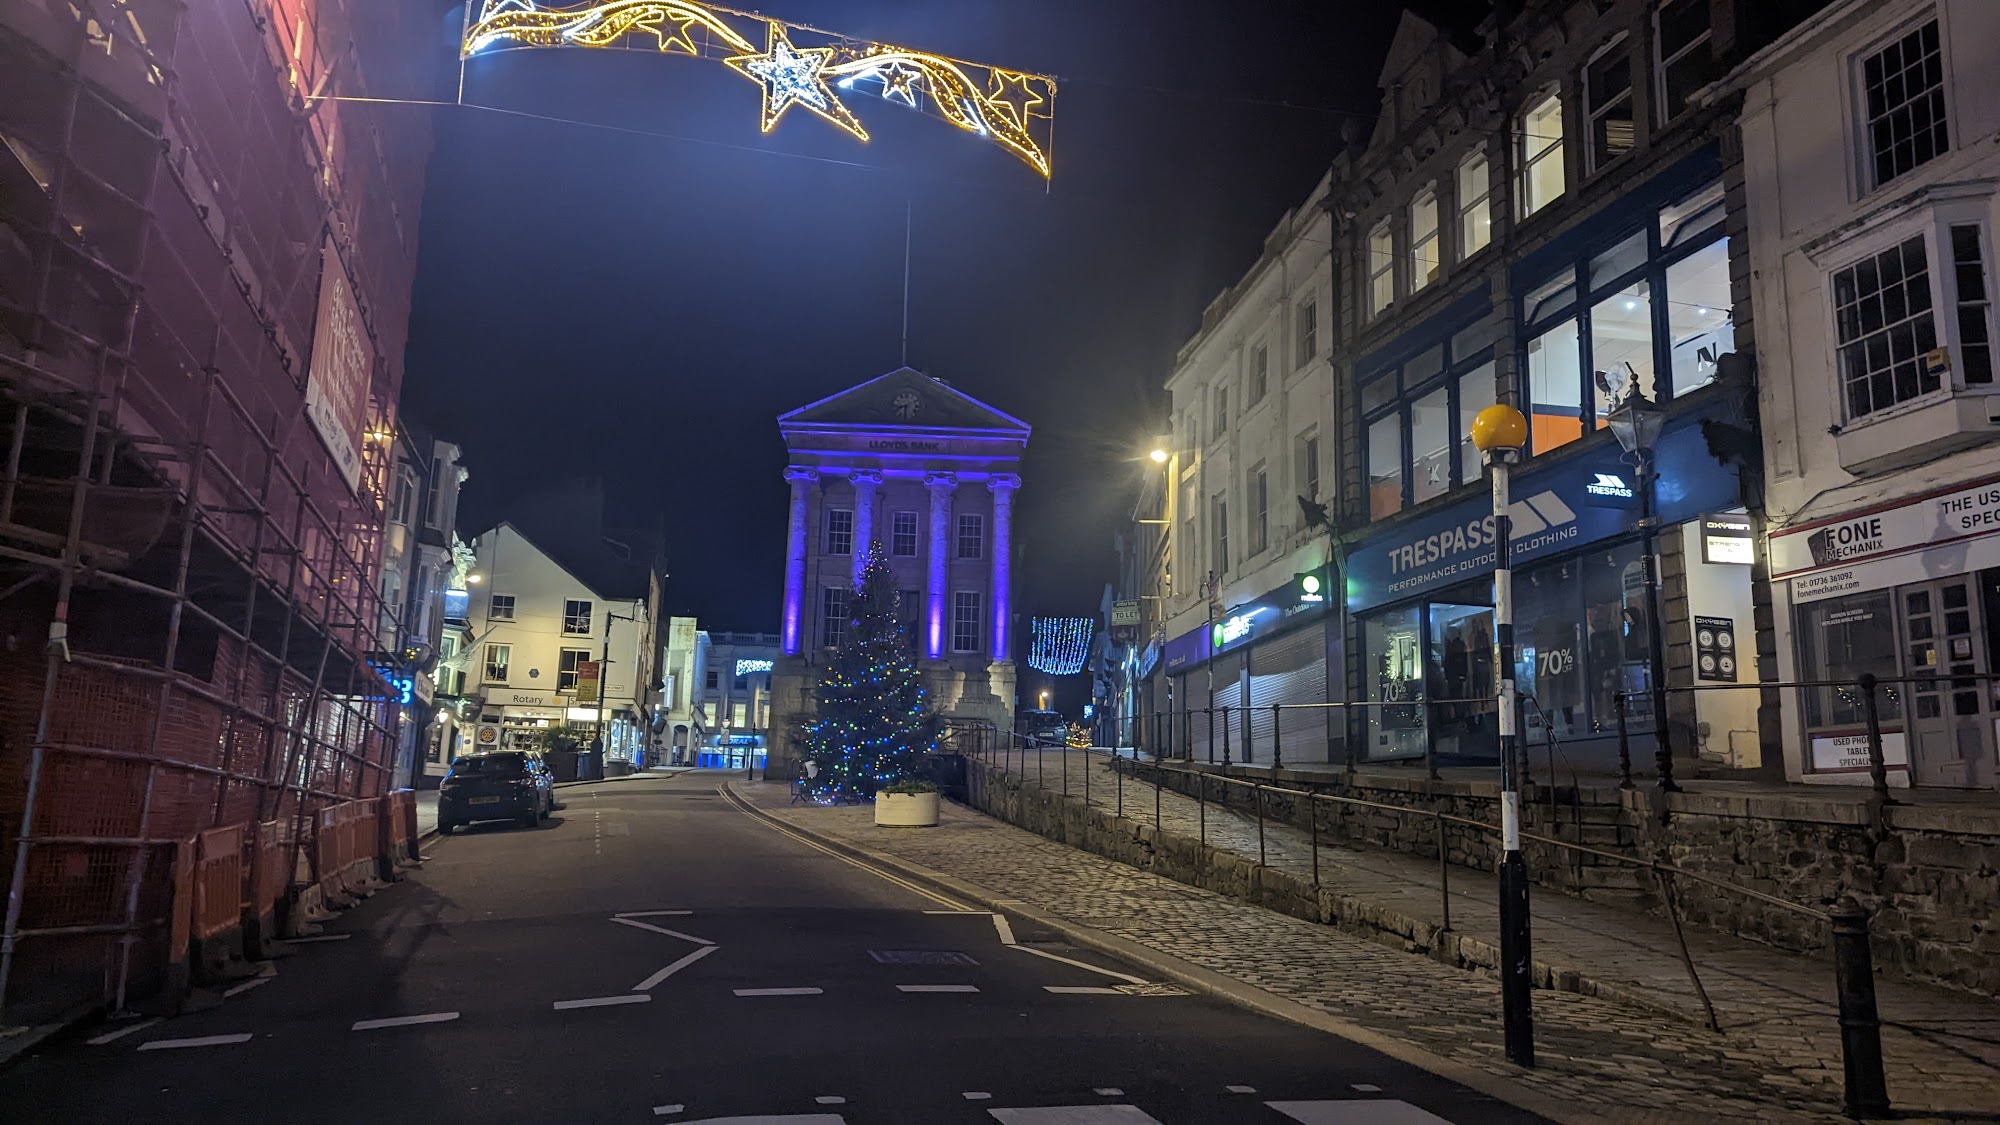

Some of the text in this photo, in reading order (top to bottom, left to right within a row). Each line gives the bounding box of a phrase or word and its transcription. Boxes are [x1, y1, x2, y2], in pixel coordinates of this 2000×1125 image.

[869, 440, 939, 451] LLOYDS BANK
[1586, 485, 1632, 498] TRESPASS
[1941, 497, 1973, 514] THE
[1825, 518, 1882, 548] FONE
[1389, 515, 1496, 575] TRESPASS
[1827, 539, 1884, 560] MECHANIX
[1388, 526, 1578, 594] PERFORMANCE OUTDOR CLOTHING
[1796, 571, 1853, 589] Tel: 01736 361092
[1797, 580, 1860, 599] fonemechanix.com
[1538, 647, 1573, 677] 70%
[513, 694, 543, 706] Rotary
[1382, 680, 1407, 703] 70%
[1833, 736, 1870, 746] USED PHO
